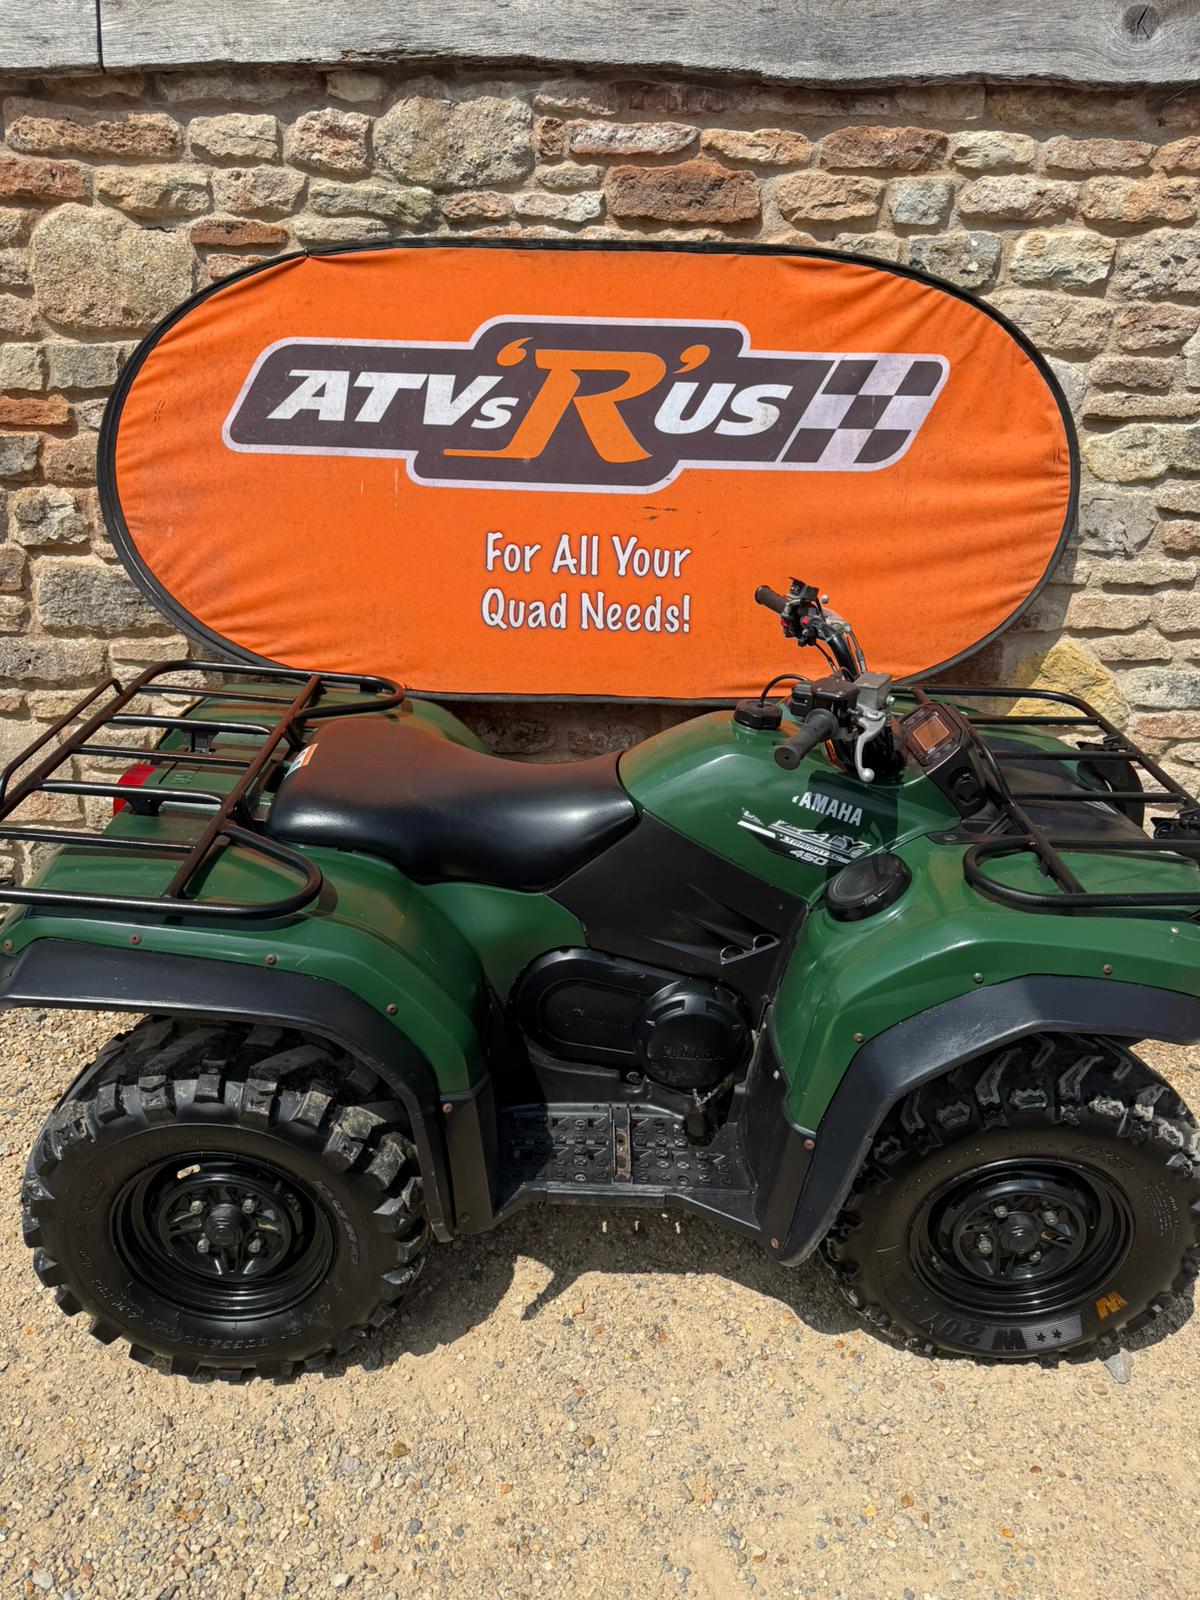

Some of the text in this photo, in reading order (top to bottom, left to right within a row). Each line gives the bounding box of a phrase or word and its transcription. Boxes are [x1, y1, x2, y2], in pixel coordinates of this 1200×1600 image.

[266, 369, 519, 429] ATVs
[485, 532, 692, 577] For All Your
[481, 587, 691, 633] Quad Needs!
[790, 849, 829, 866] 450
